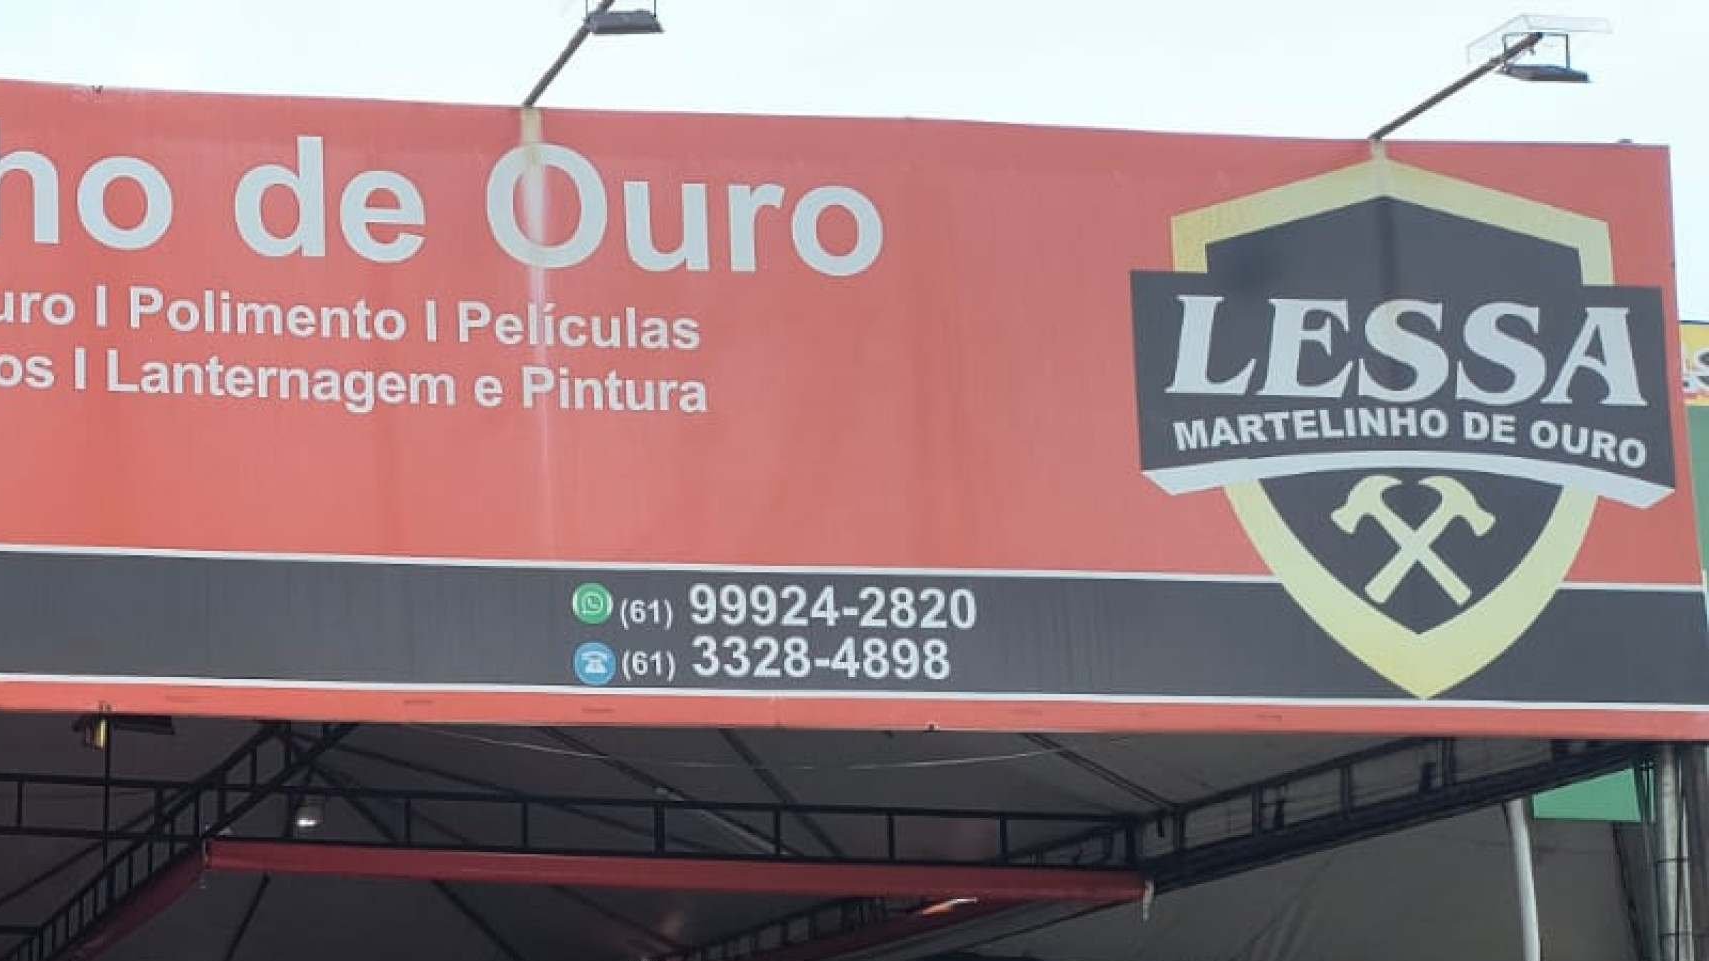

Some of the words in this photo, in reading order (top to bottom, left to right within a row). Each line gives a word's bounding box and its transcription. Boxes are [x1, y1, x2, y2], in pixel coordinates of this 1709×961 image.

[235, 136, 425, 262] de
[487, 142, 883, 277] Ouro
[131, 286, 406, 340] Polimento
[459, 302, 699, 350] Películas
[108, 350, 455, 412] Lanternagem
[475, 376, 502, 406] e
[522, 366, 707, 412] Pintura
[1166, 295, 1647, 406] LESSA
[1173, 408, 1448, 450] MARTELINHO
[1464, 412, 1515, 444] DE
[1529, 421, 1645, 470] OURO
[620, 599, 673, 630] (61)
[690, 583, 976, 628] 99924-2820
[622, 651, 675, 681] (61)
[693, 636, 949, 679] 3328-4898
